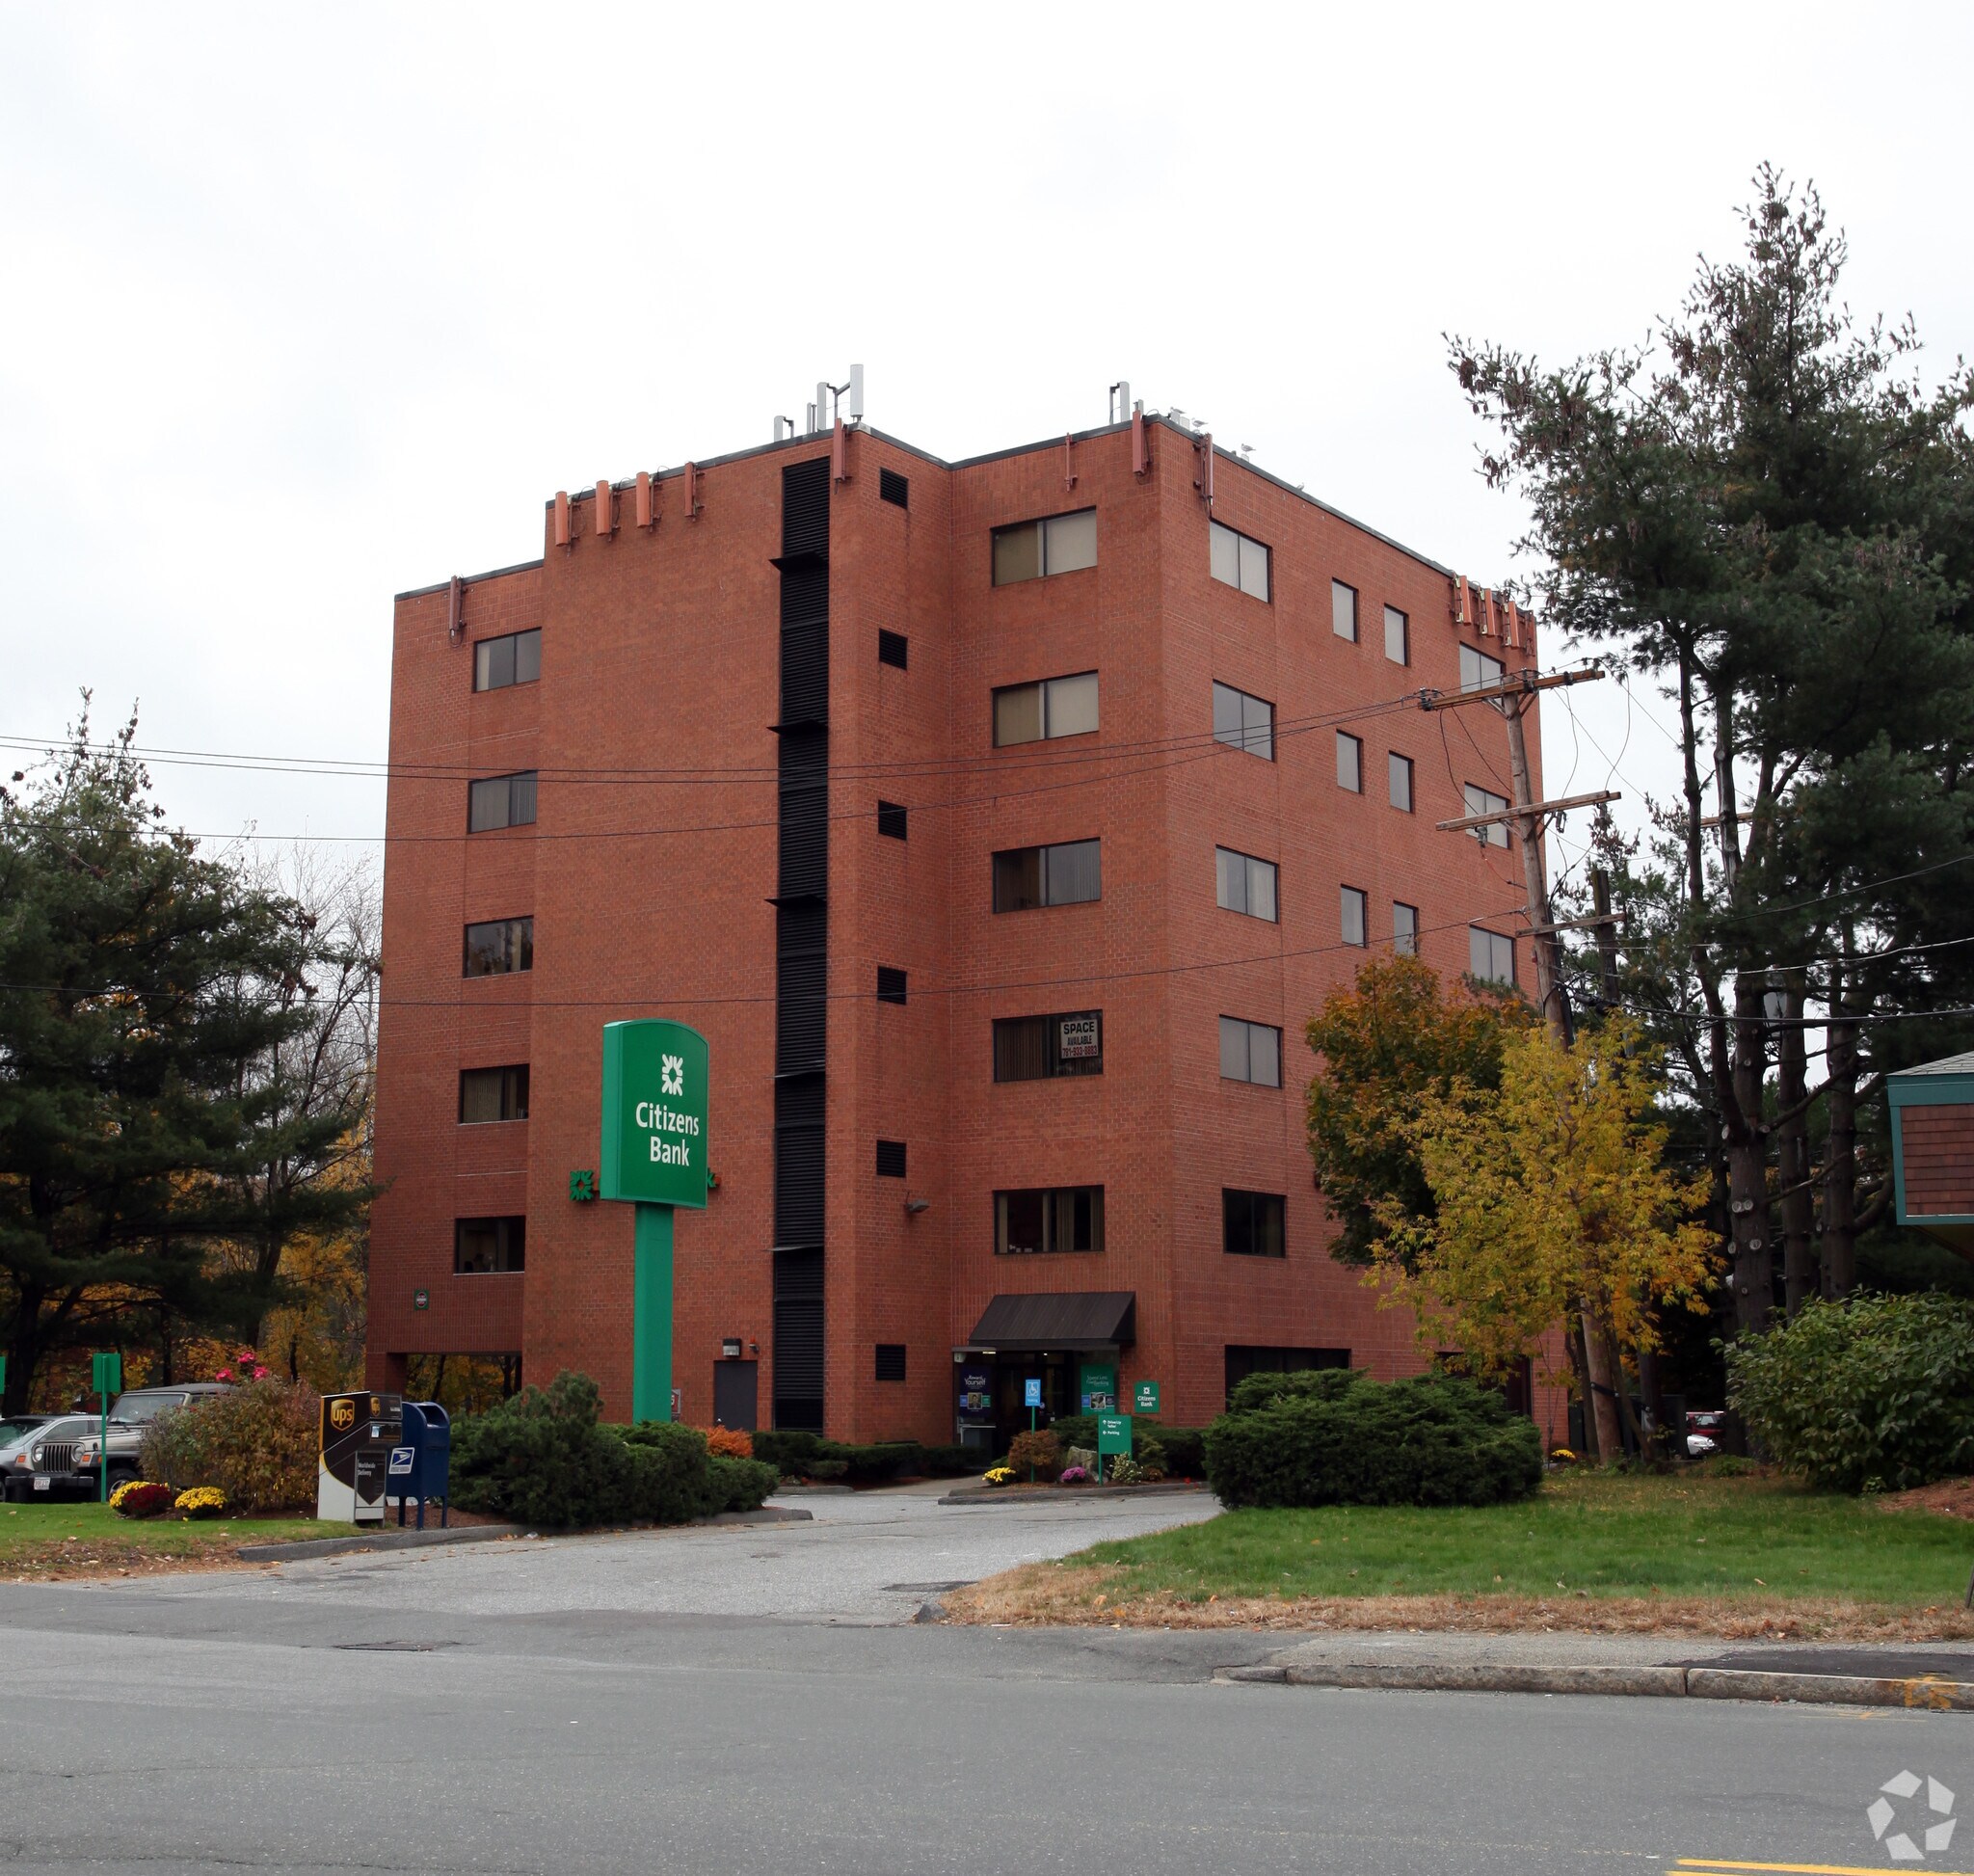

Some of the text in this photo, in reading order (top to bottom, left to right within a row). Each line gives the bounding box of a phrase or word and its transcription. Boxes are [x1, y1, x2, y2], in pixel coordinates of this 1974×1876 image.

[1064, 1022, 1095, 1034] SPACE
[1067, 1035, 1092, 1045] AVAILABLE
[635, 1102, 699, 1136] Citizens
[650, 1136, 689, 1166] Bank
[964, 1378, 986, 1386] Yourself
[333, 1408, 353, 1427] ups
